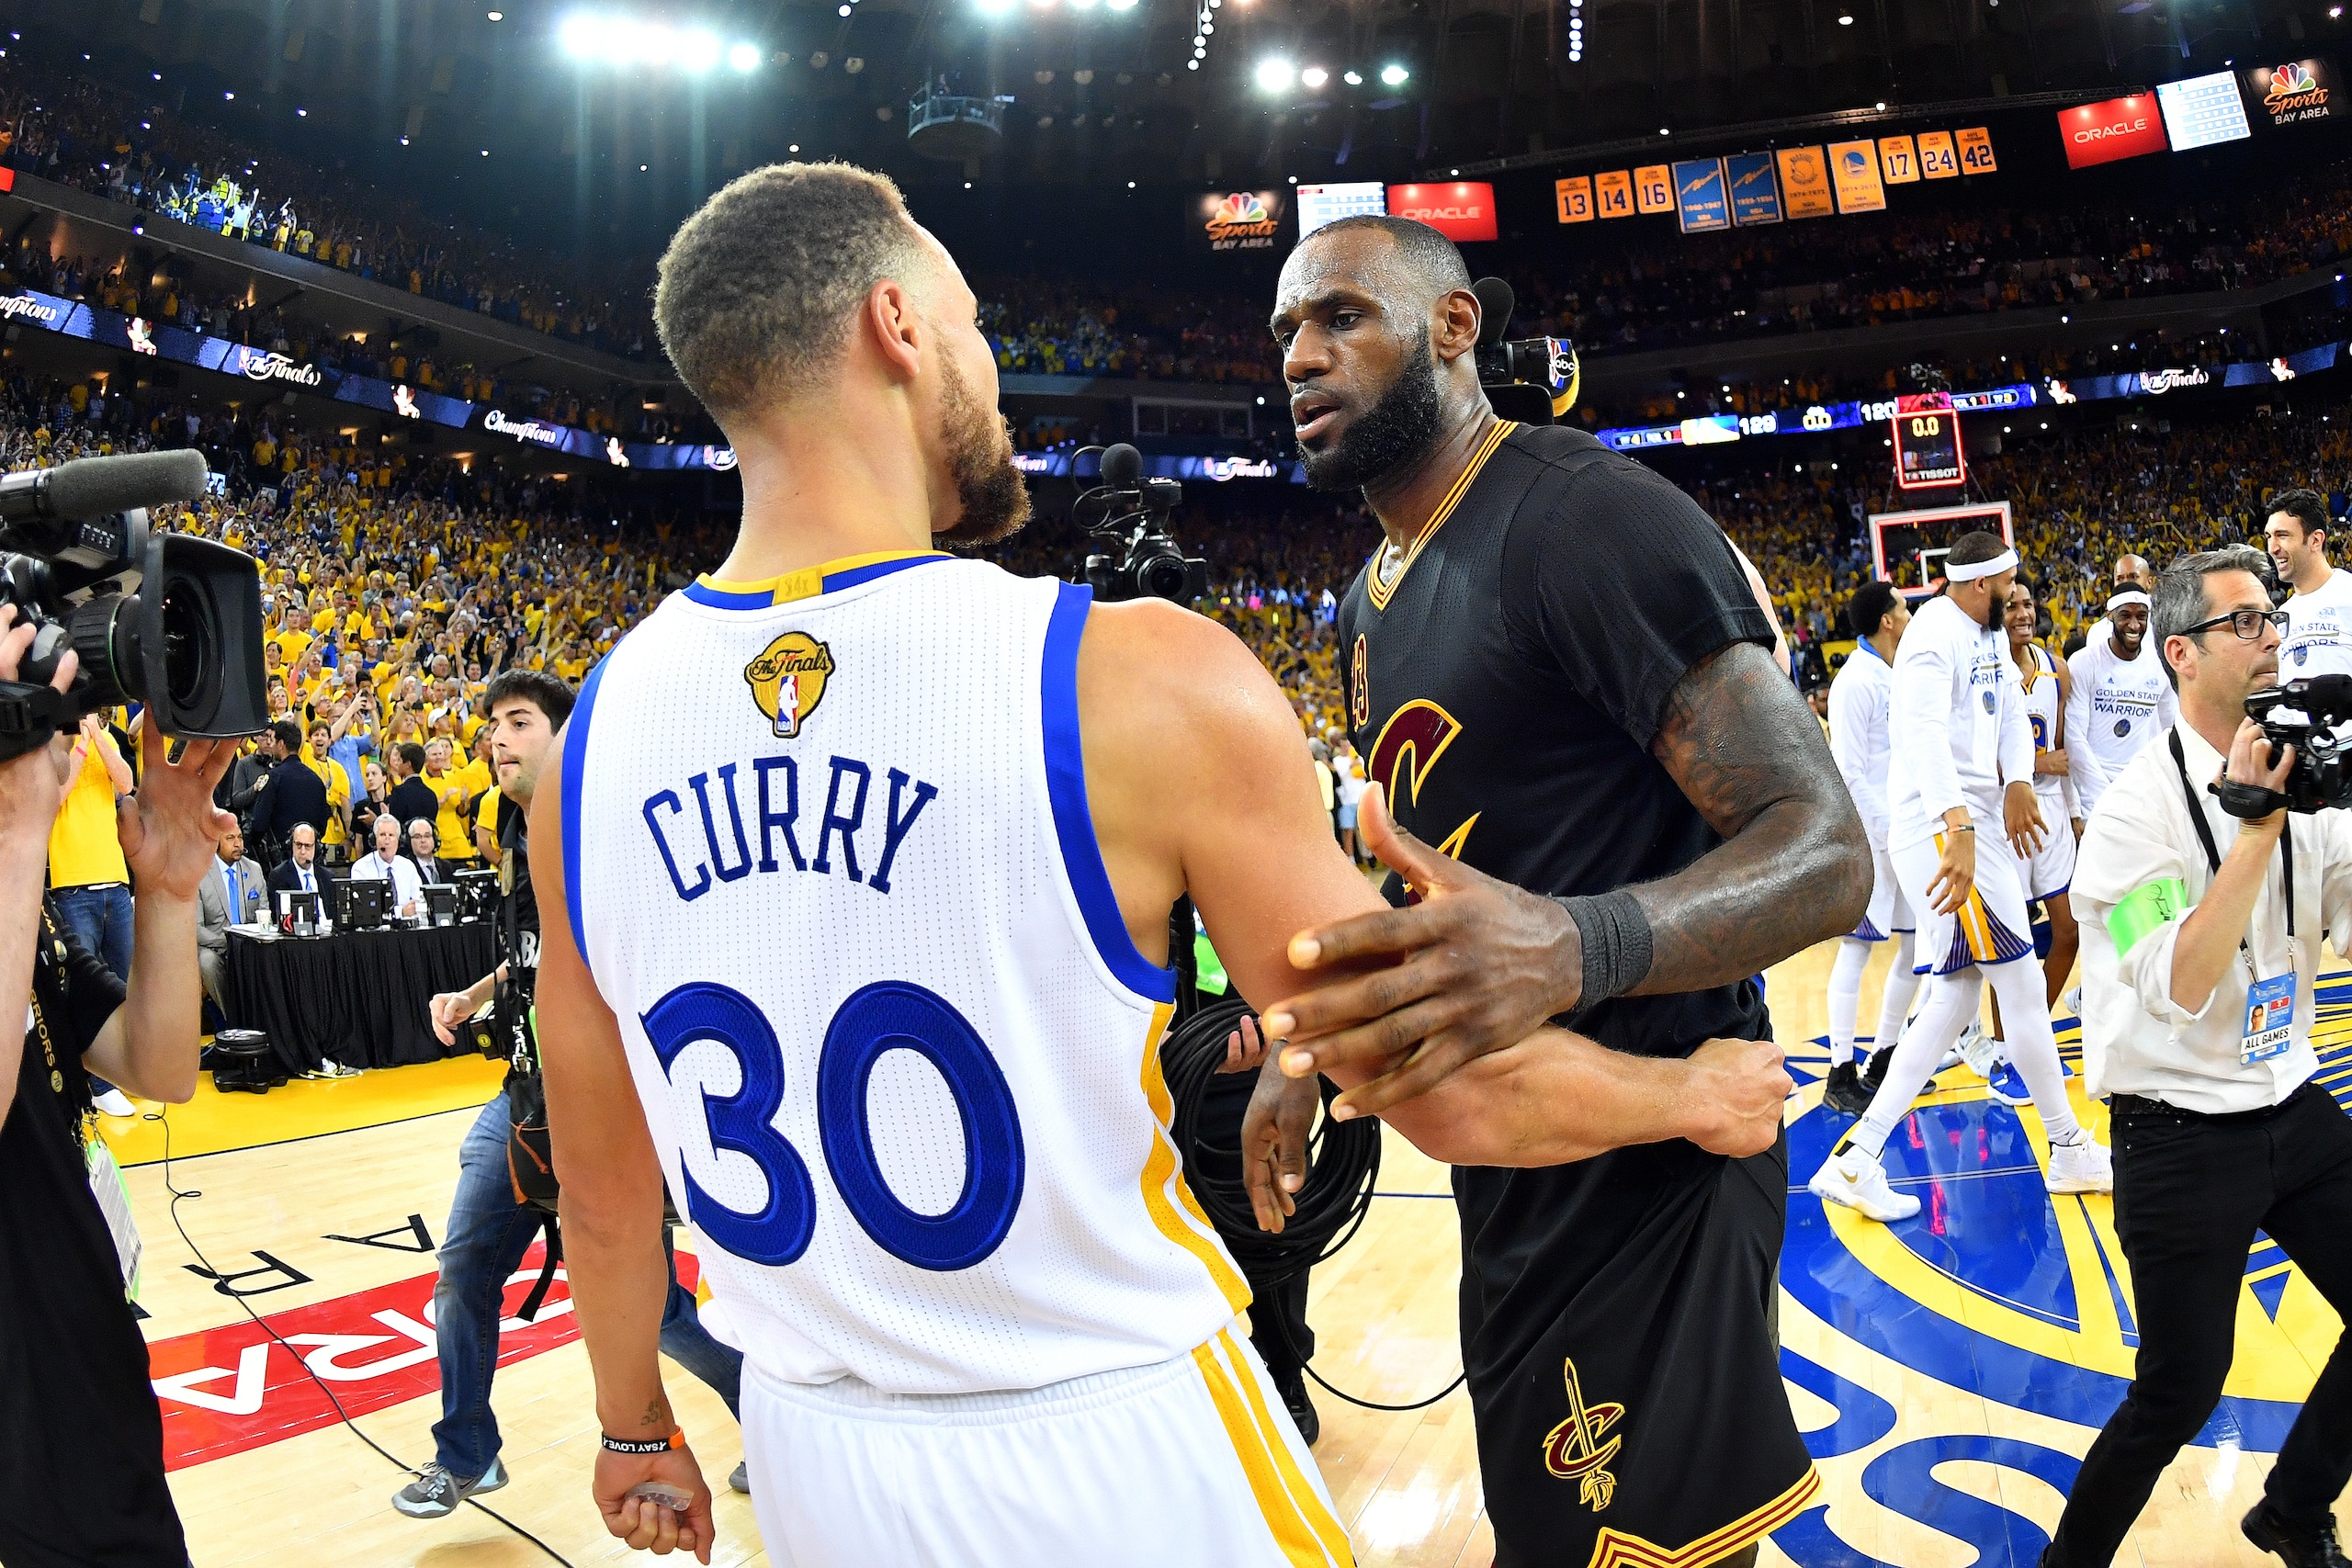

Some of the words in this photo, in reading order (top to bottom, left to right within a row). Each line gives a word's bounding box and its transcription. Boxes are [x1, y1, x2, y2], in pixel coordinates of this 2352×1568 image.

[2264, 87, 2328, 115] Sports
[2275, 112, 2296, 124] BAY
[2299, 107, 2329, 120] AREA
[2074, 118, 2148, 143] ORACLE
[1888, 153, 1907, 176] 17
[1924, 149, 1953, 172] 24
[1965, 144, 1992, 167] 42
[1564, 194, 1586, 216] 13
[1604, 188, 1626, 211] 14
[1644, 184, 1666, 206] 16
[1401, 206, 1481, 220] ORACLE
[1204, 218, 1278, 241] Sports
[1212, 239, 1238, 251] BAY
[1239, 237, 1273, 248] AREA
[1555, 356, 1575, 371] abc
[1860, 401, 1898, 421] 120
[1911, 416, 1939, 437] 0.0
[1918, 468, 1958, 480] TISSOT
[775, 648, 830, 674] Finals
[2096, 689, 2135, 698] GOLDEN
[643, 755, 939, 902] CURRY
[2245, 1038, 2260, 1049] ALL
[2262, 1027, 2290, 1044] GAMES
[638, 979, 1025, 1271] 30
[609, 1439, 637, 1452] LOVE
[638, 1442, 659, 1452] SAY
